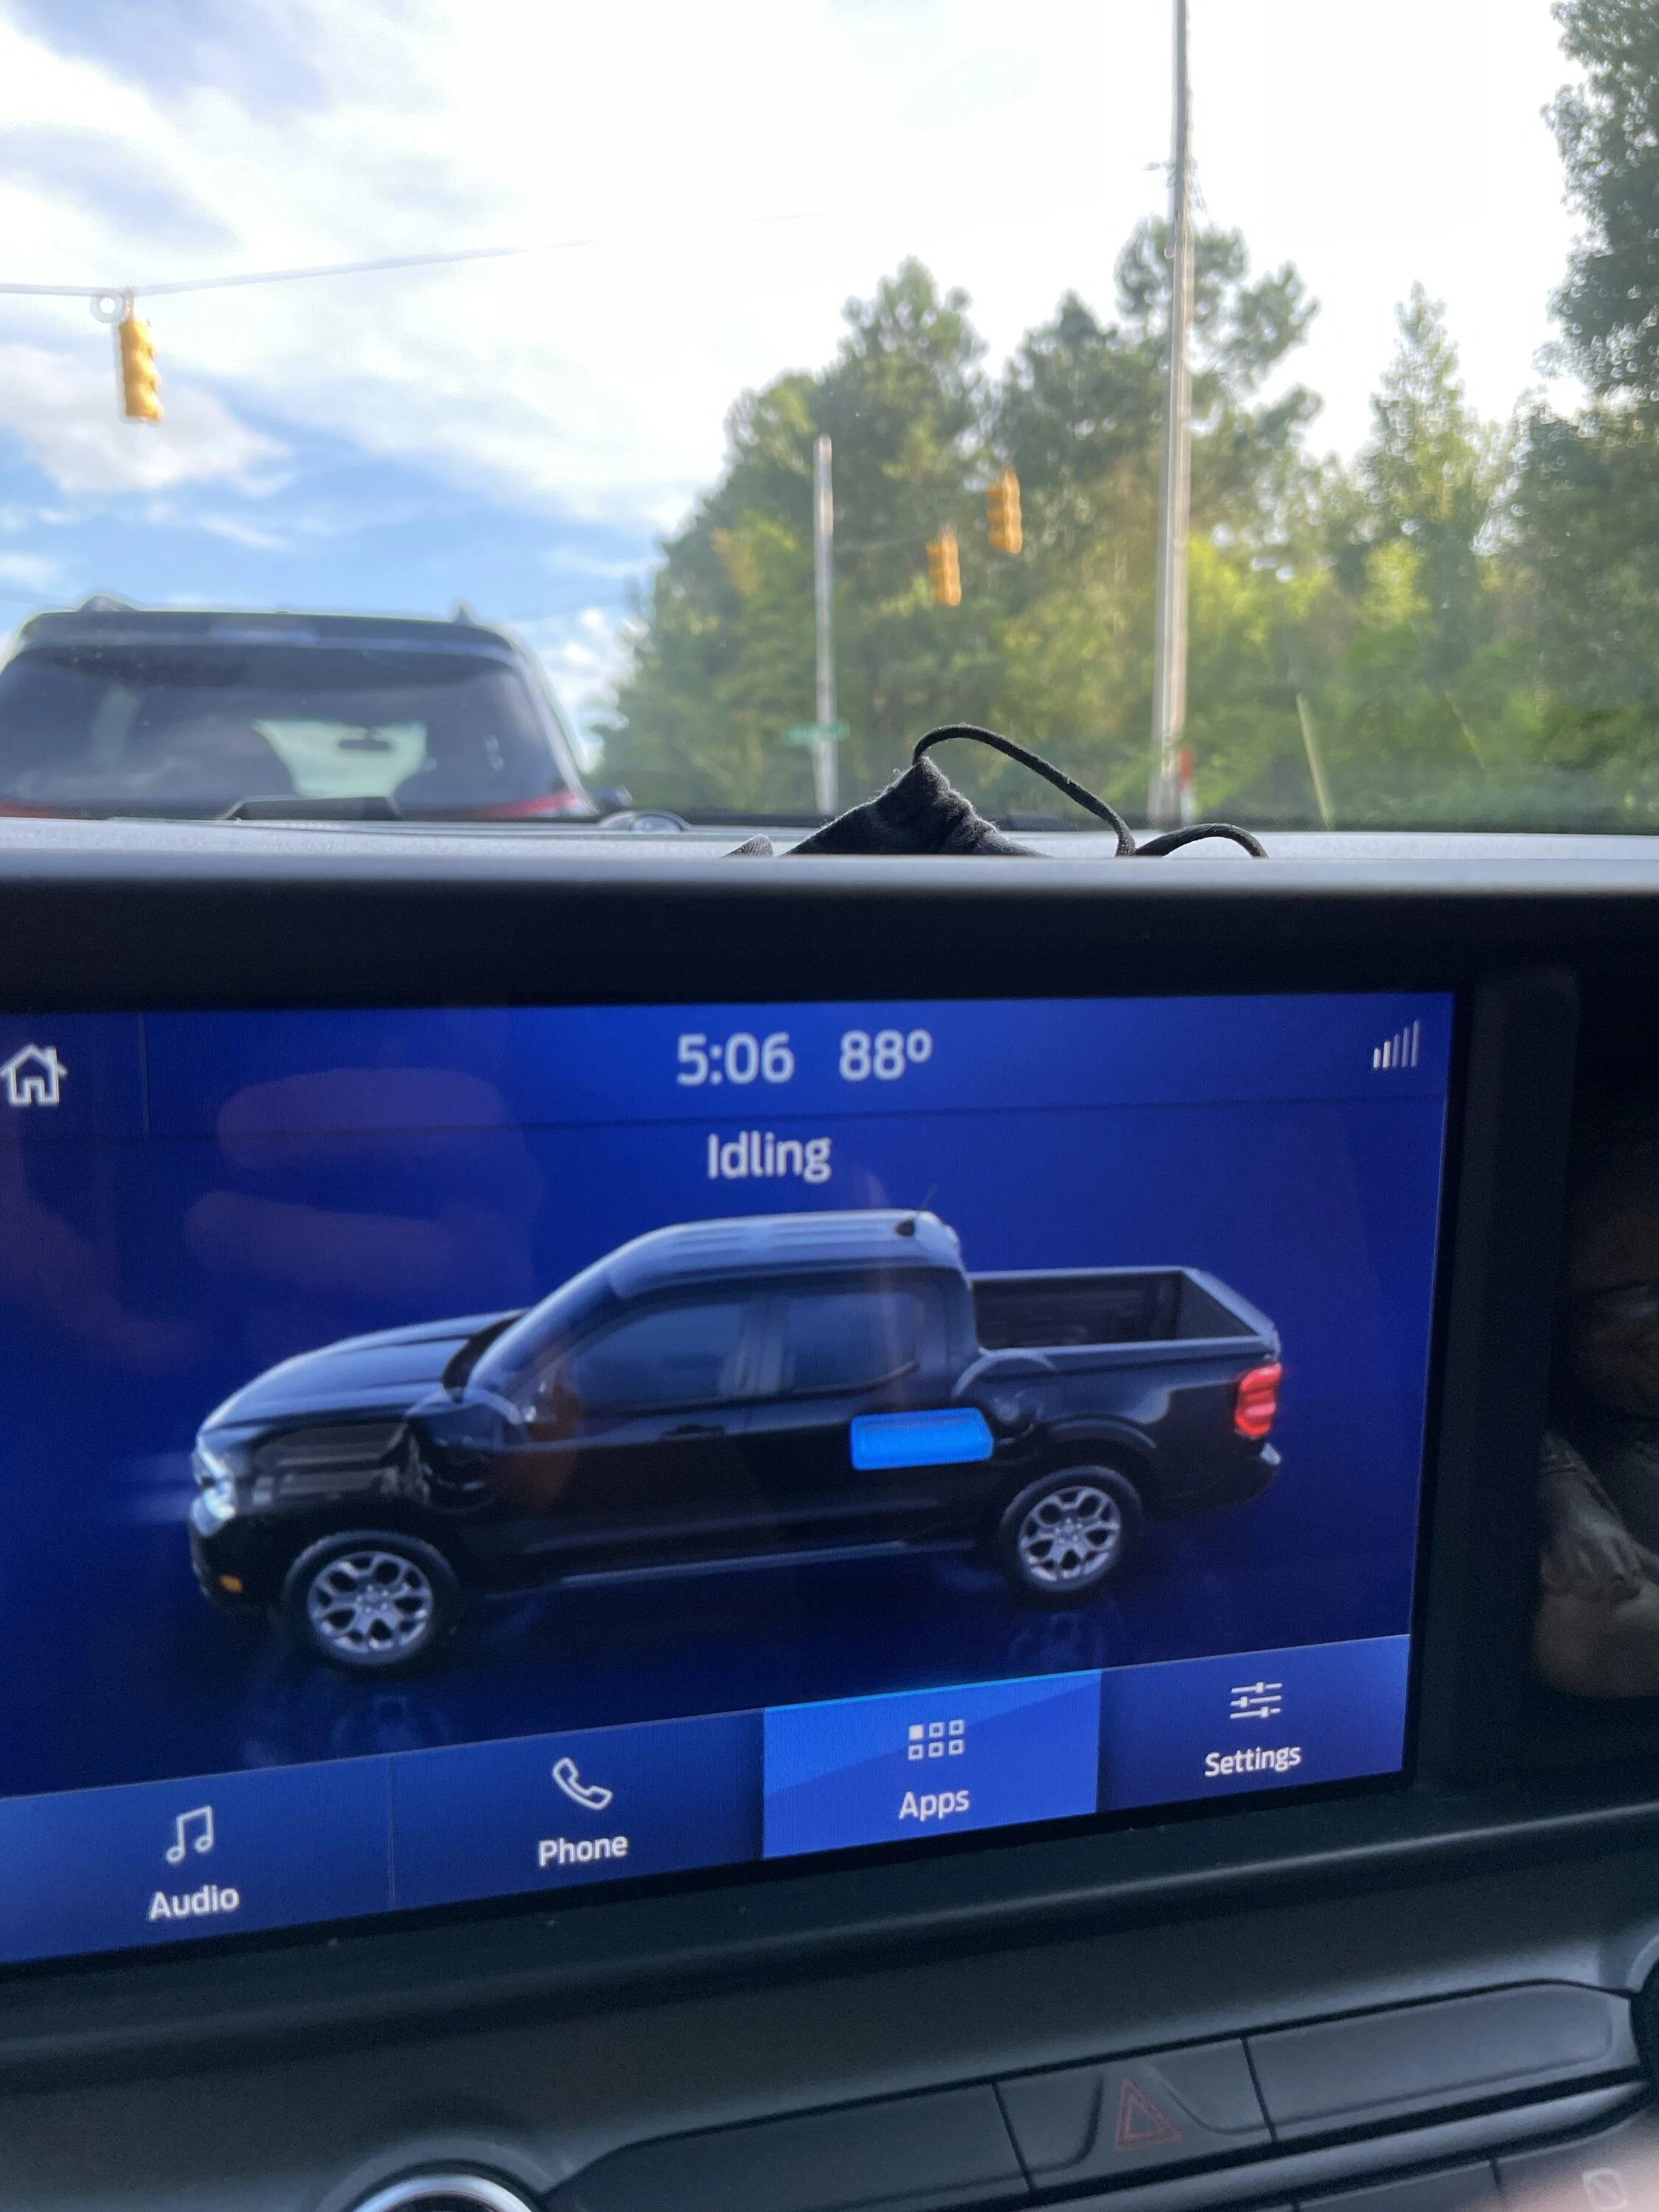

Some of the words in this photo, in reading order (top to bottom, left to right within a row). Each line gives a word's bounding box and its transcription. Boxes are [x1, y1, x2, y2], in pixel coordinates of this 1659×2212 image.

[676, 1032, 795, 1086] 5:06
[707, 1130, 832, 1183] Idling
[1203, 1743, 1301, 1777] Settings
[898, 1787, 970, 1823] Apps
[538, 1834, 629, 1867] Phone
[148, 1883, 240, 1921] Audio
